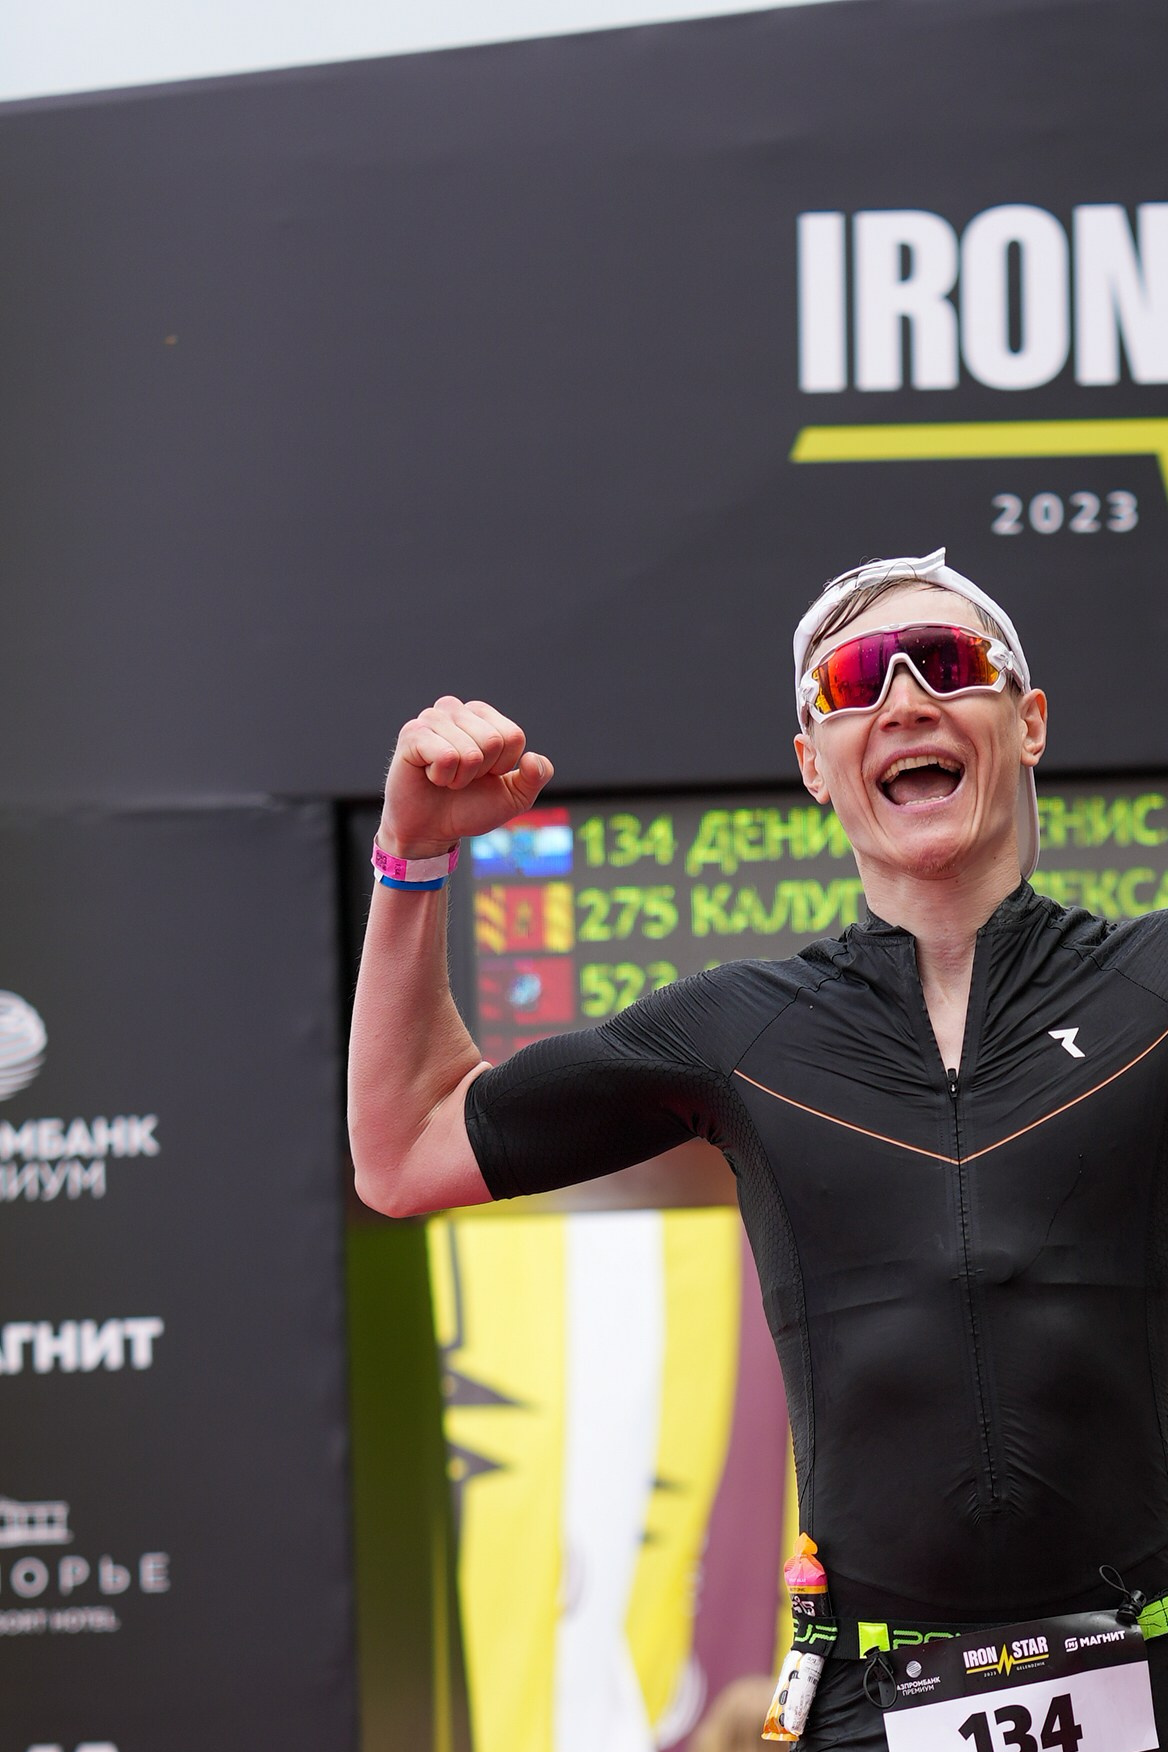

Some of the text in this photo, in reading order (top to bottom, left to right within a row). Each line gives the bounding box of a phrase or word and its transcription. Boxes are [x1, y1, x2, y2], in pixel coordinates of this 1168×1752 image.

[992, 490, 1139, 535] 2023
[579, 794, 1168, 875] 134 ДЕНИ ЕНИС
[574, 886, 678, 942] 275
[0, 1158, 106, 1201] ИУМ
[0, 1317, 164, 1375] ГНИТ
[10, 1552, 170, 1598] ОРЬЕ
[963, 1636, 1049, 1669] IRON STAR
[1080, 1629, 1126, 1648] МАГНИТ
[896, 1676, 941, 1691] АЗПРОМБАНК
[902, 1684, 935, 1696] ПРЕМИУМ
